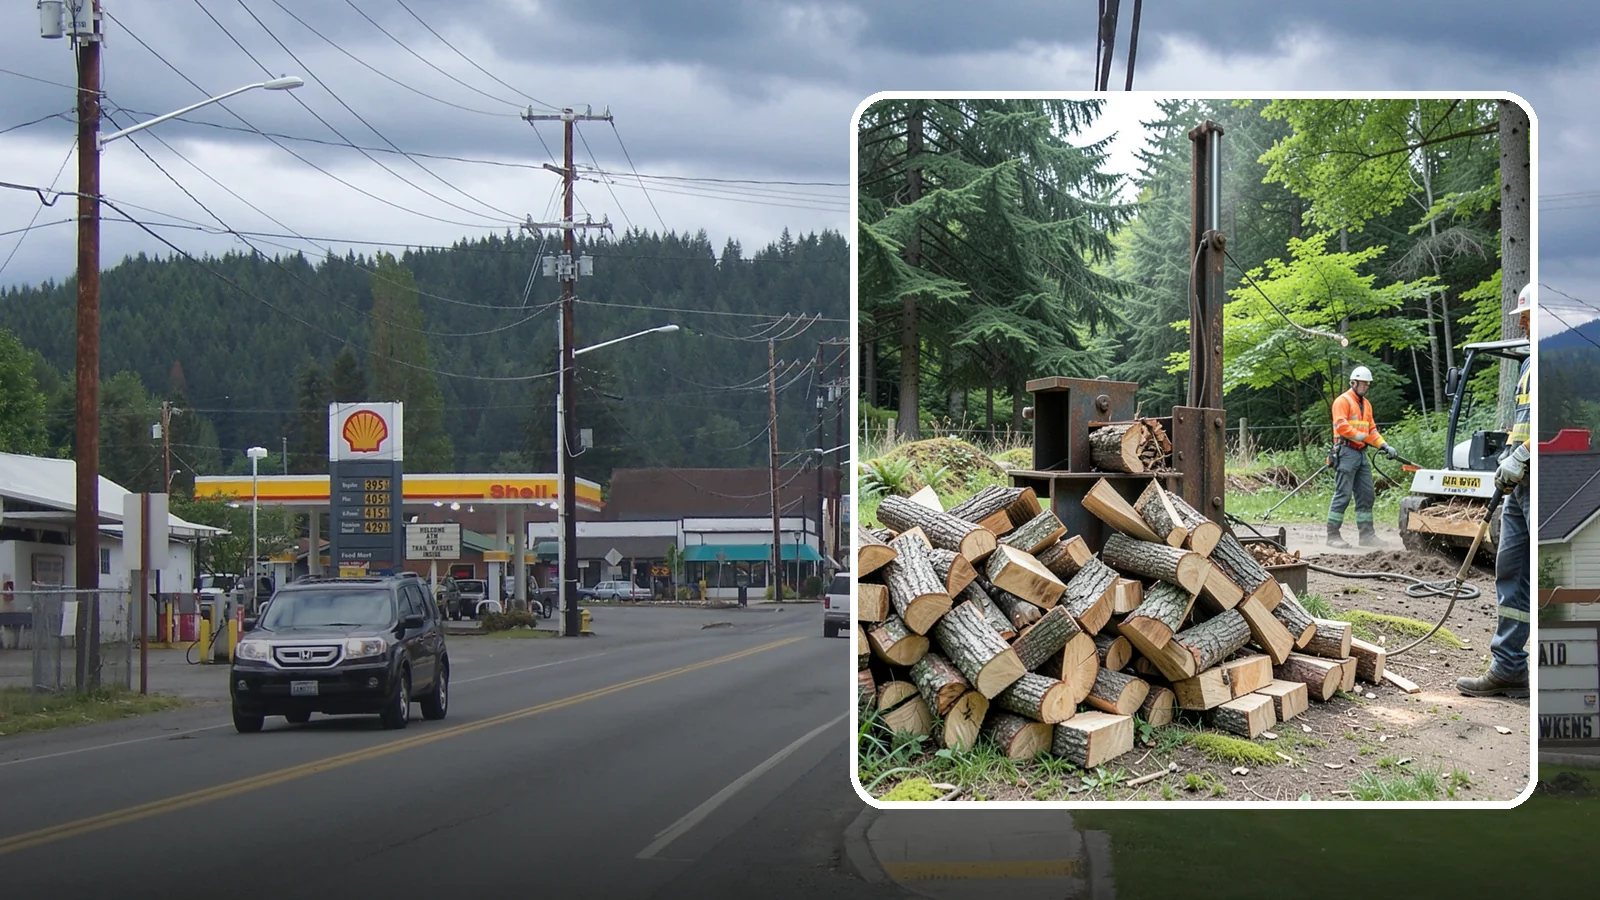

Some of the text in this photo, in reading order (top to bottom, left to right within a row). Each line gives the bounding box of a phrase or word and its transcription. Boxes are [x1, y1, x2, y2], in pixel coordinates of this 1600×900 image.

[366, 480, 383, 490] 395
[490, 484, 547, 499] Shell
[366, 494, 383, 504] 405
[366, 508, 383, 518] 415
[366, 522, 383, 532] 429
[1539, 643, 1567, 665] AID
